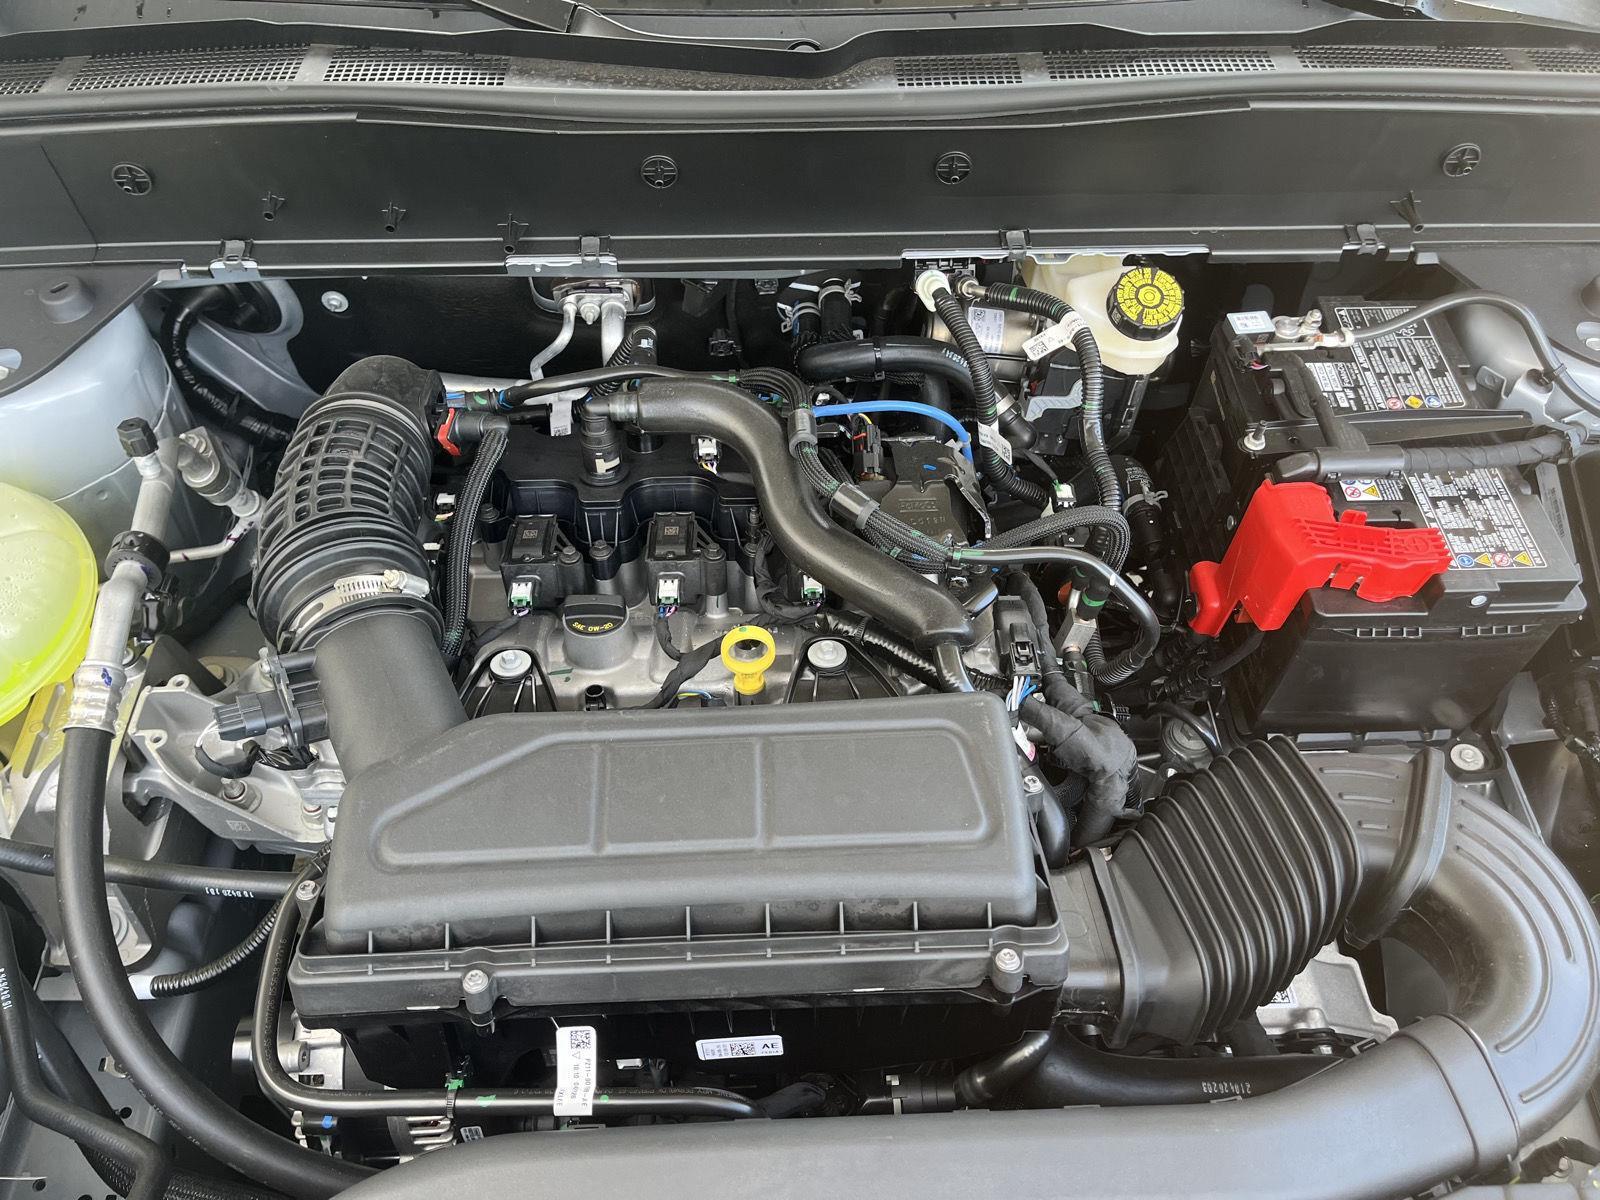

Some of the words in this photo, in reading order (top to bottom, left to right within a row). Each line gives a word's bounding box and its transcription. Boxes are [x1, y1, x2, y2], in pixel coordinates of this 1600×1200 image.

[1337, 363, 1351, 386] FoMoCo
[572, 621, 586, 631] SAE
[588, 622, 614, 632] 0W-20
